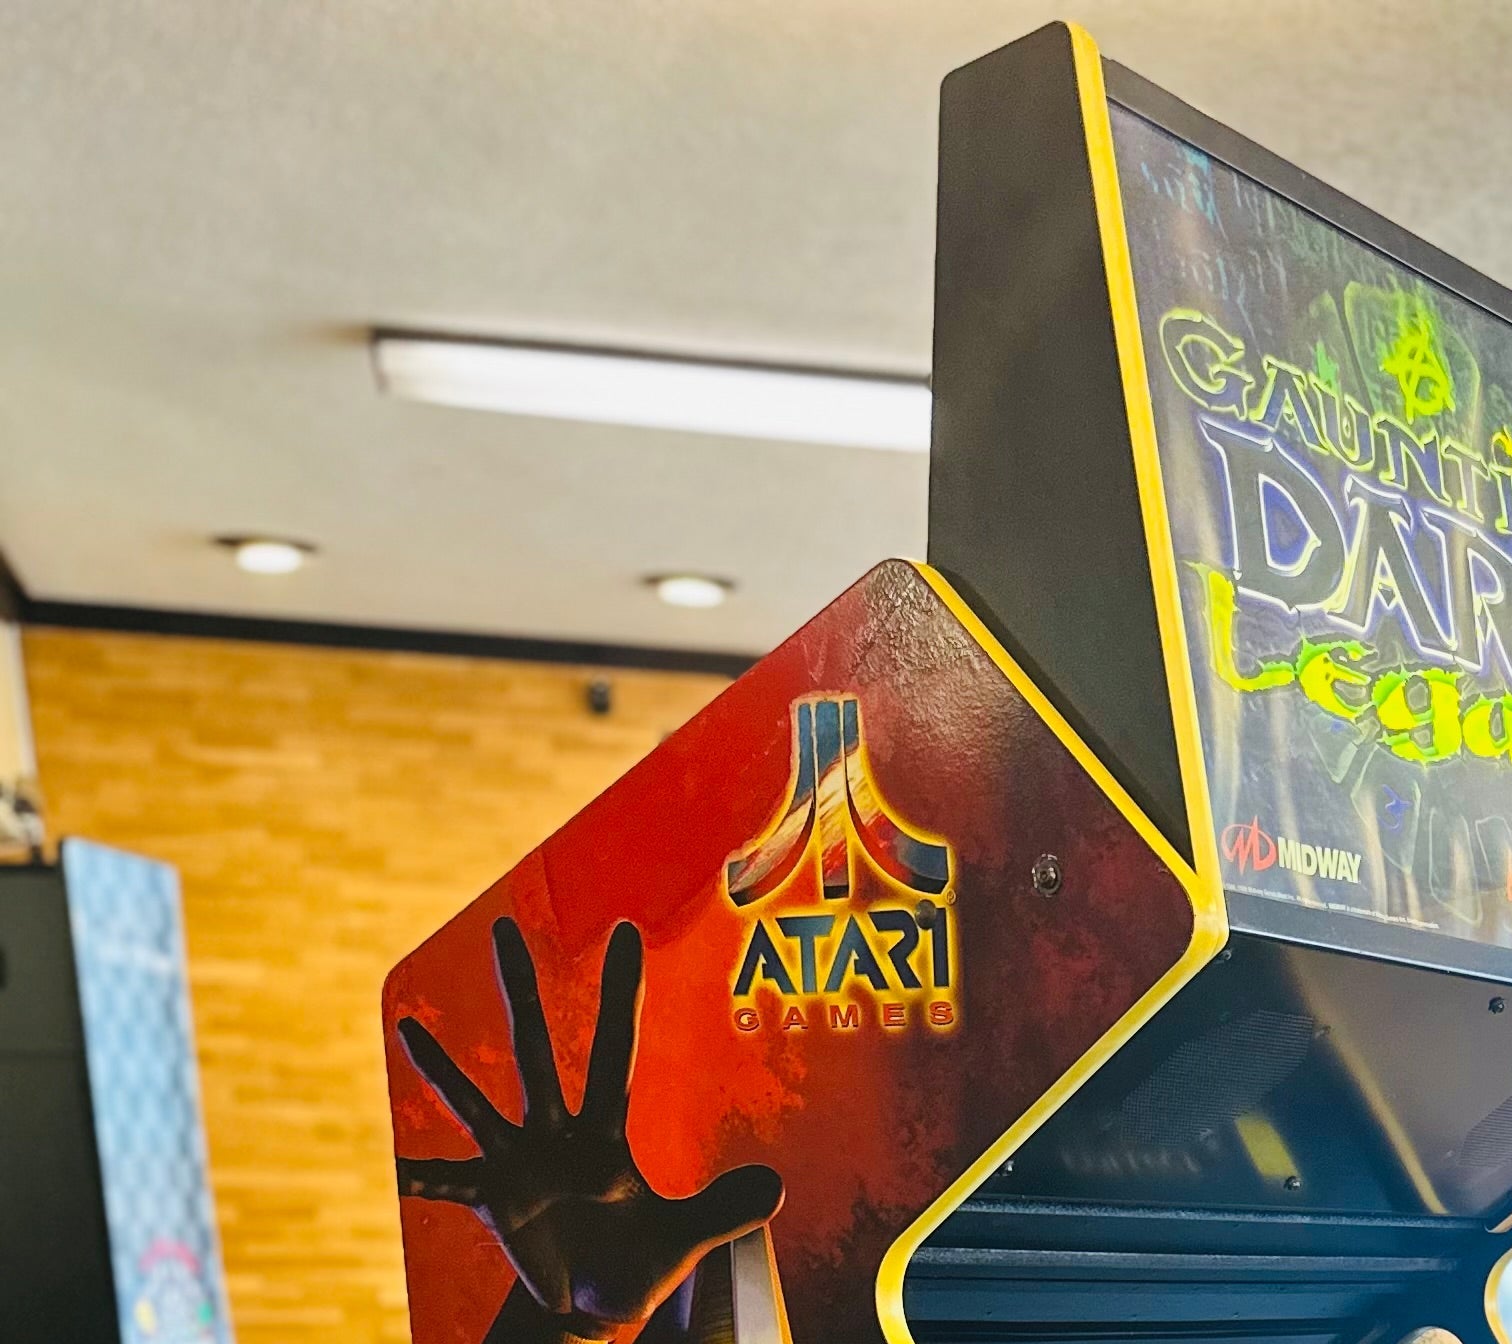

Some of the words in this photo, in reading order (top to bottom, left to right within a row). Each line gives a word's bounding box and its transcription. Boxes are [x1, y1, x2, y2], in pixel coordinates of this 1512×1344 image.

[1277, 836, 1362, 884] MIDWAY
[732, 905, 952, 998] ATARI
[734, 1001, 956, 1032] GAMES
